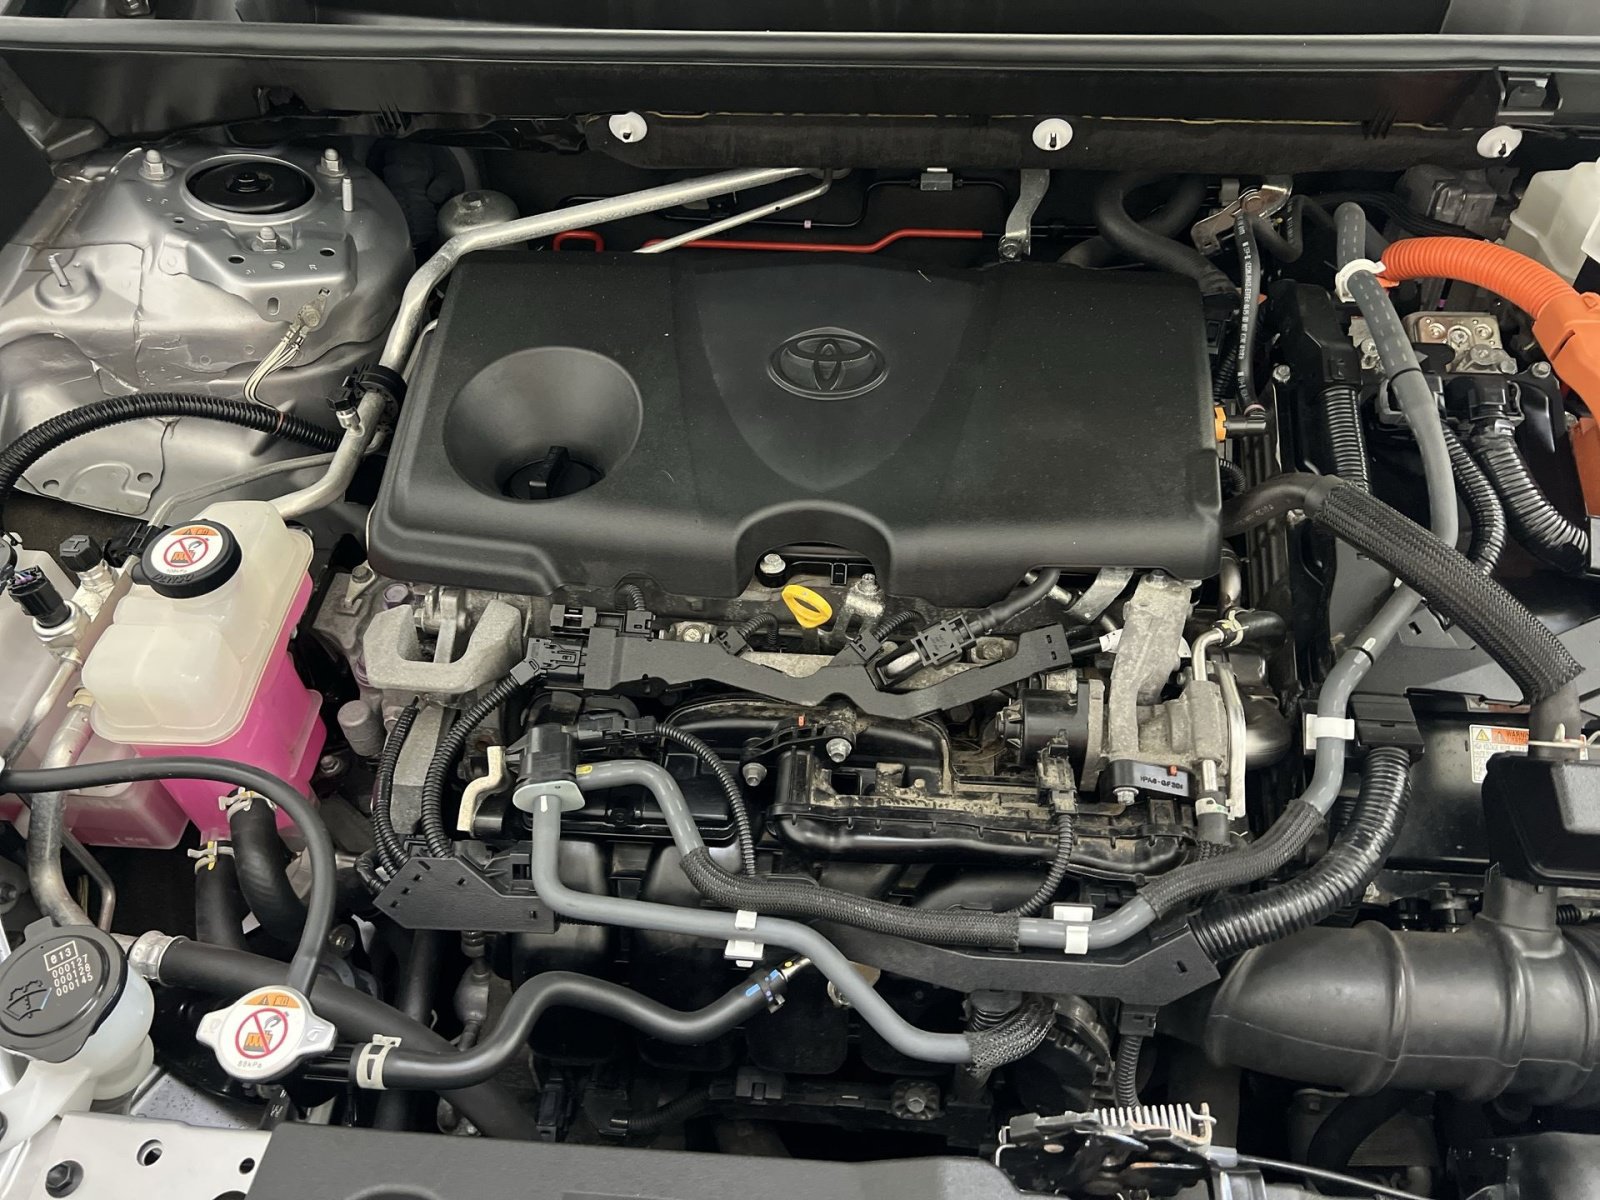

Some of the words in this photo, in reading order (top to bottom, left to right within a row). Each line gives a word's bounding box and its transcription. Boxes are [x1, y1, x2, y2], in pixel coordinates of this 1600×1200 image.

[152, 573, 195, 584] DENSO
[52, 954, 88, 978] 000127
[54, 964, 91, 987] 000128
[56, 974, 93, 996] 000145
